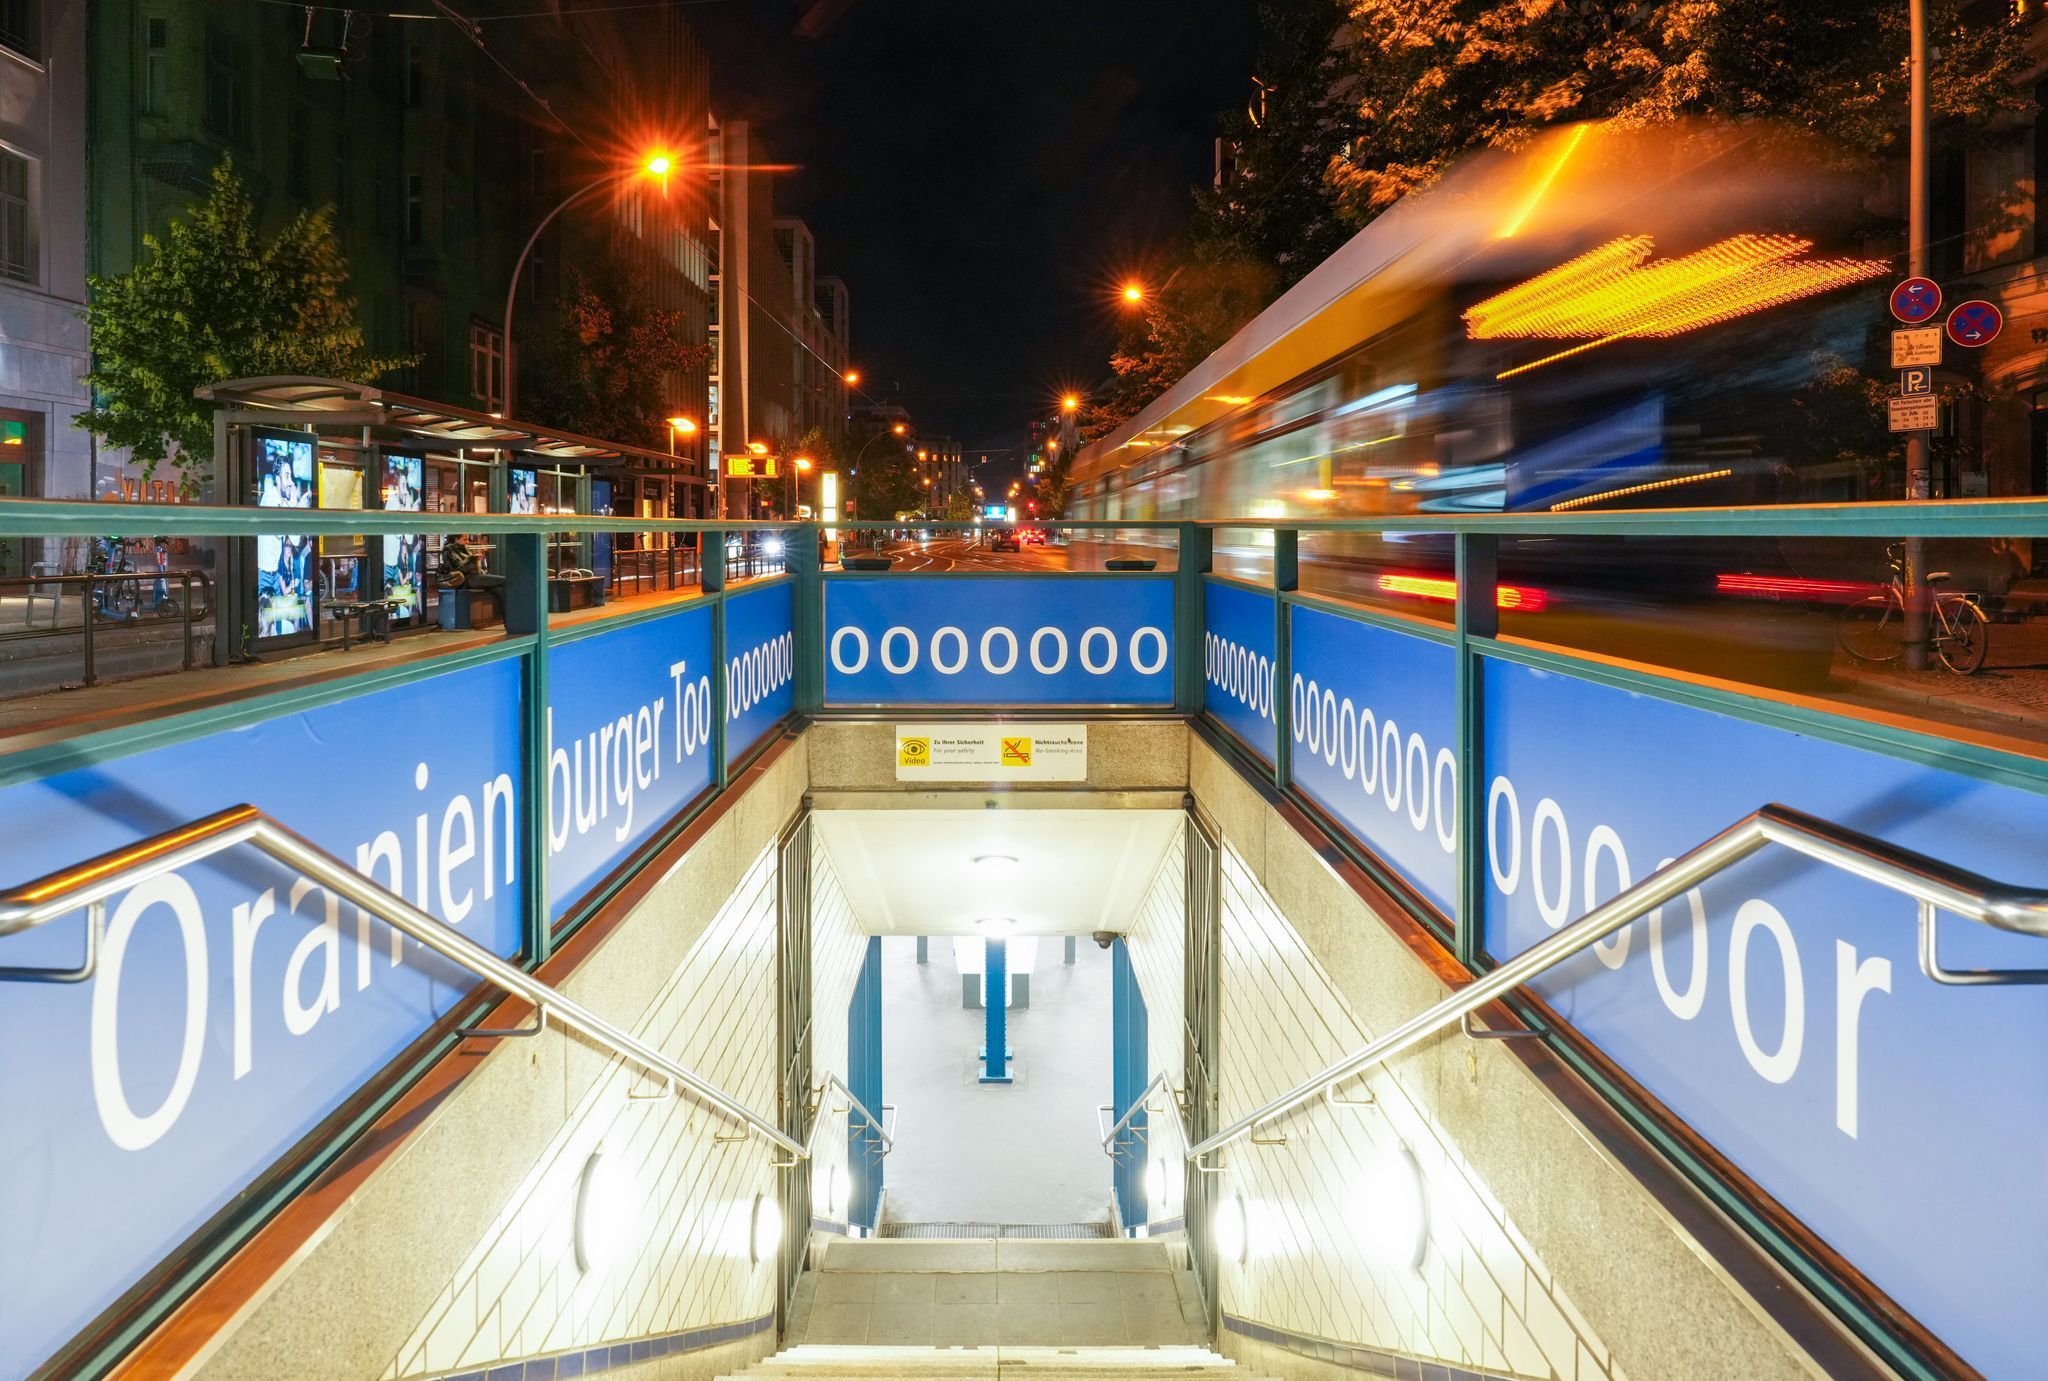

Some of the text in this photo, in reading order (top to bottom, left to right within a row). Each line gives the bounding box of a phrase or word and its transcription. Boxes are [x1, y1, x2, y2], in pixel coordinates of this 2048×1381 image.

[1908, 371, 1924, 392] P
[547, 660, 711, 857] burger Too
[904, 757, 926, 765] Video
[91, 763, 516, 1152] Oranien
